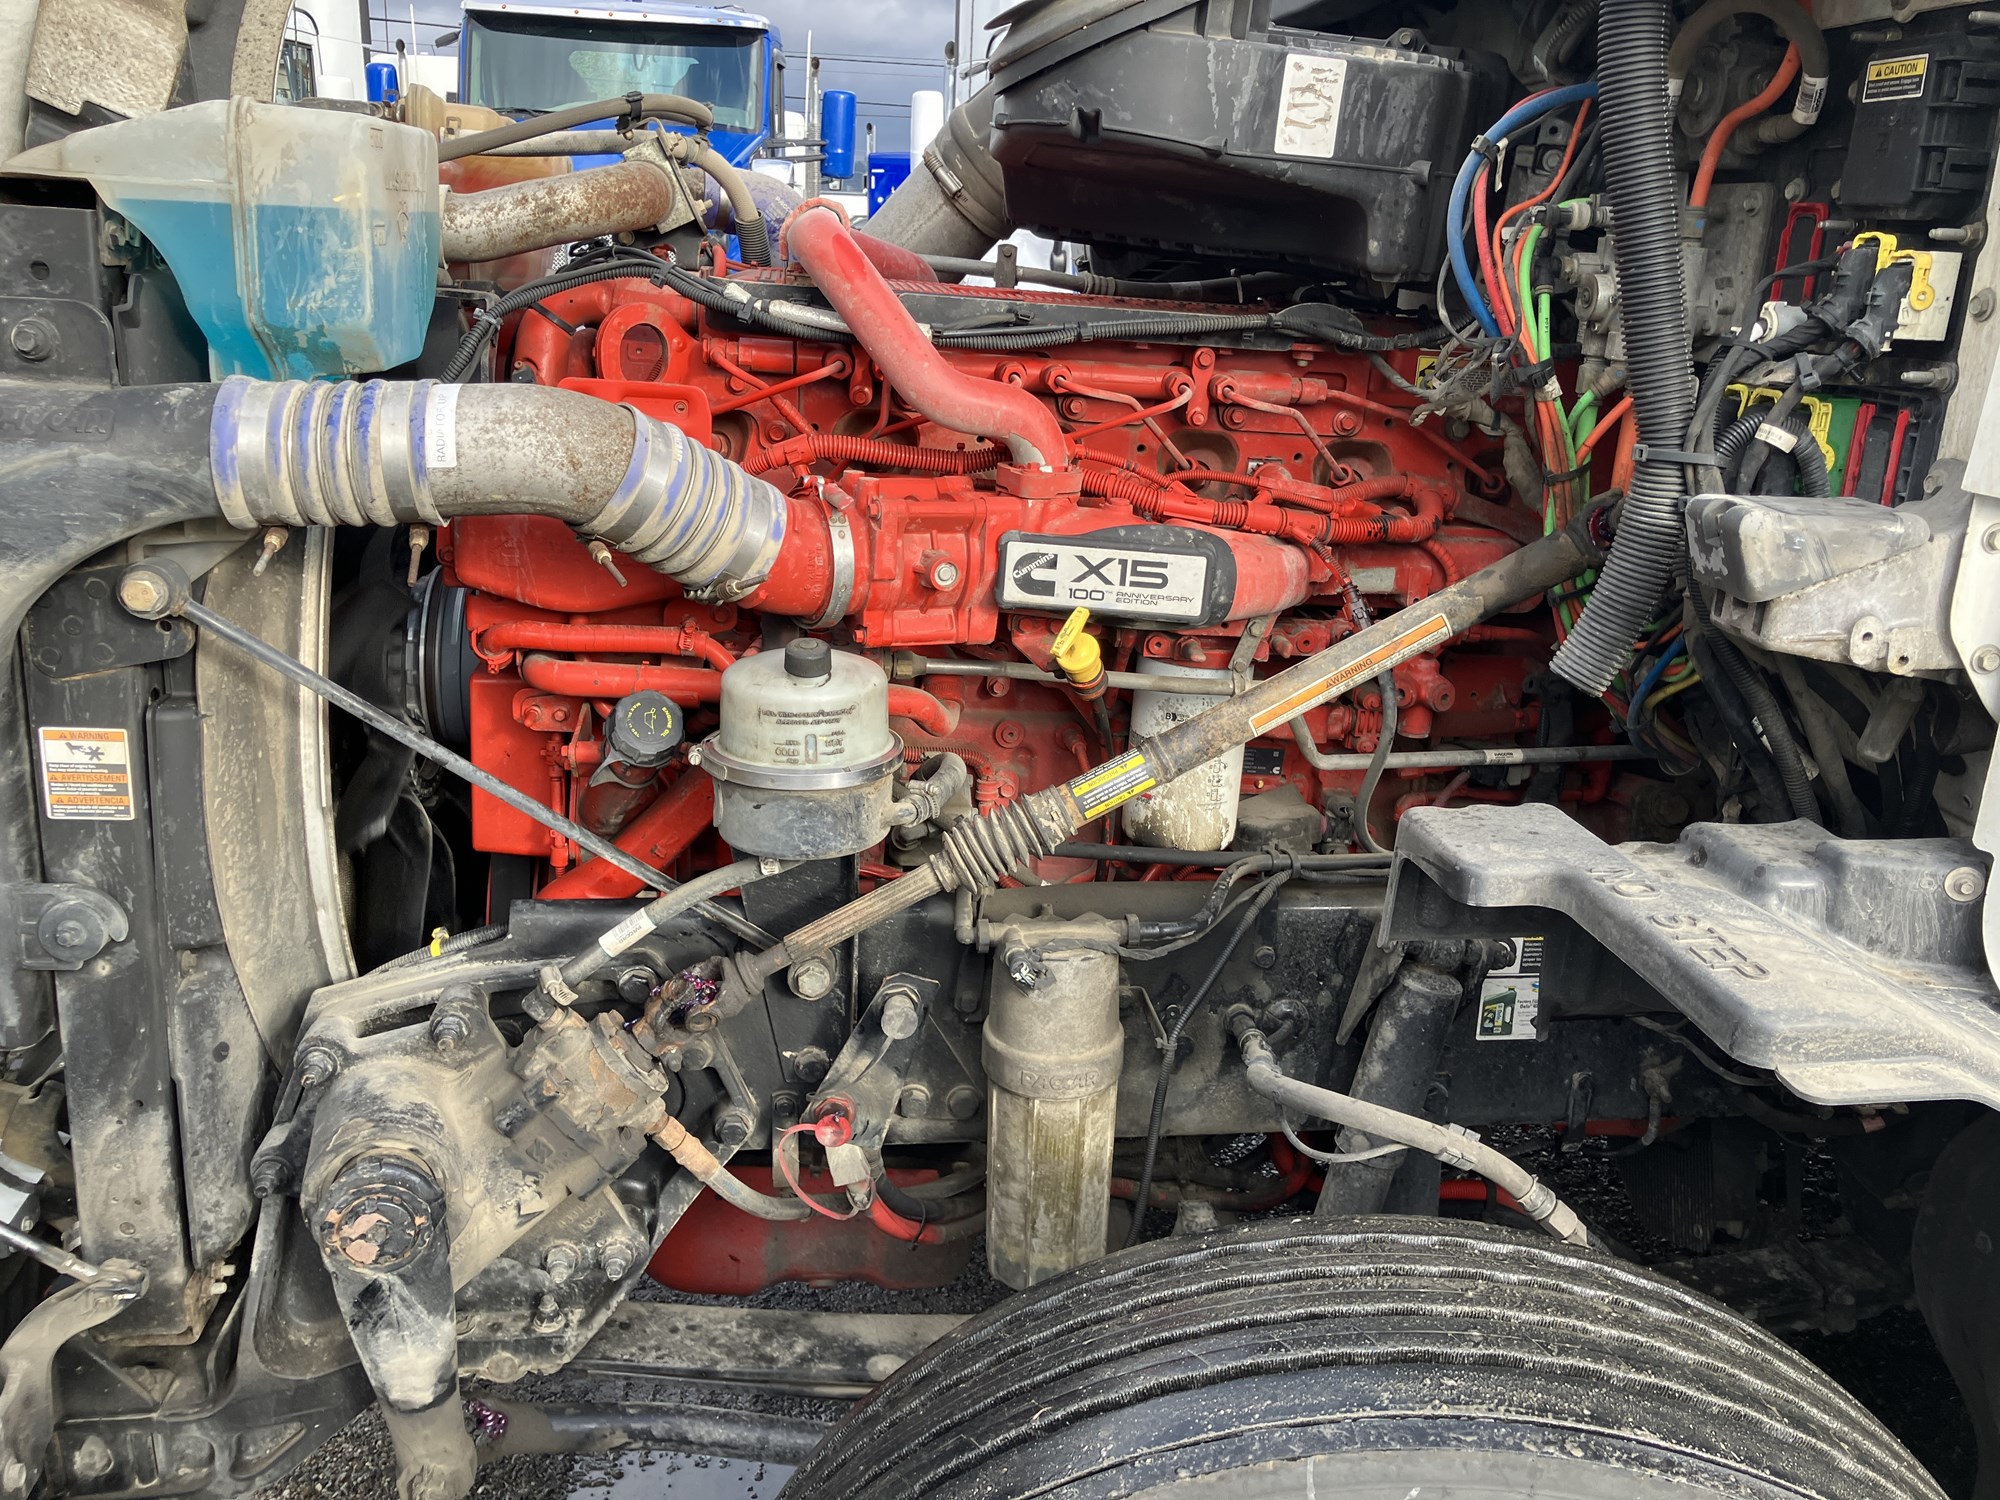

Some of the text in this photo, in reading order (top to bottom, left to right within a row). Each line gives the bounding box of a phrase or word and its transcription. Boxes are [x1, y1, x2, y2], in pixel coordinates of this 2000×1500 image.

[1884, 62, 1918, 76] CAUTION
[1012, 552, 1055, 579] Cummins
[1069, 555, 1169, 590] X15
[1115, 598, 1158, 606] EDITION
[1116, 591, 1195, 604] ANNIVERSARY
[1331, 658, 1373, 685] WARNING
[660, 706, 673, 737] ENGINE OIL
[69, 732, 110, 740] WARNING
[774, 746, 799, 757] COLD
[60, 774, 126, 782] AVERTISSEMENT
[67, 796, 125, 804] ADVERTENCIA
[1590, 867, 1661, 900] NO
[1650, 913, 1771, 982] STEP
[1020, 1069, 1100, 1091] PACCAR
